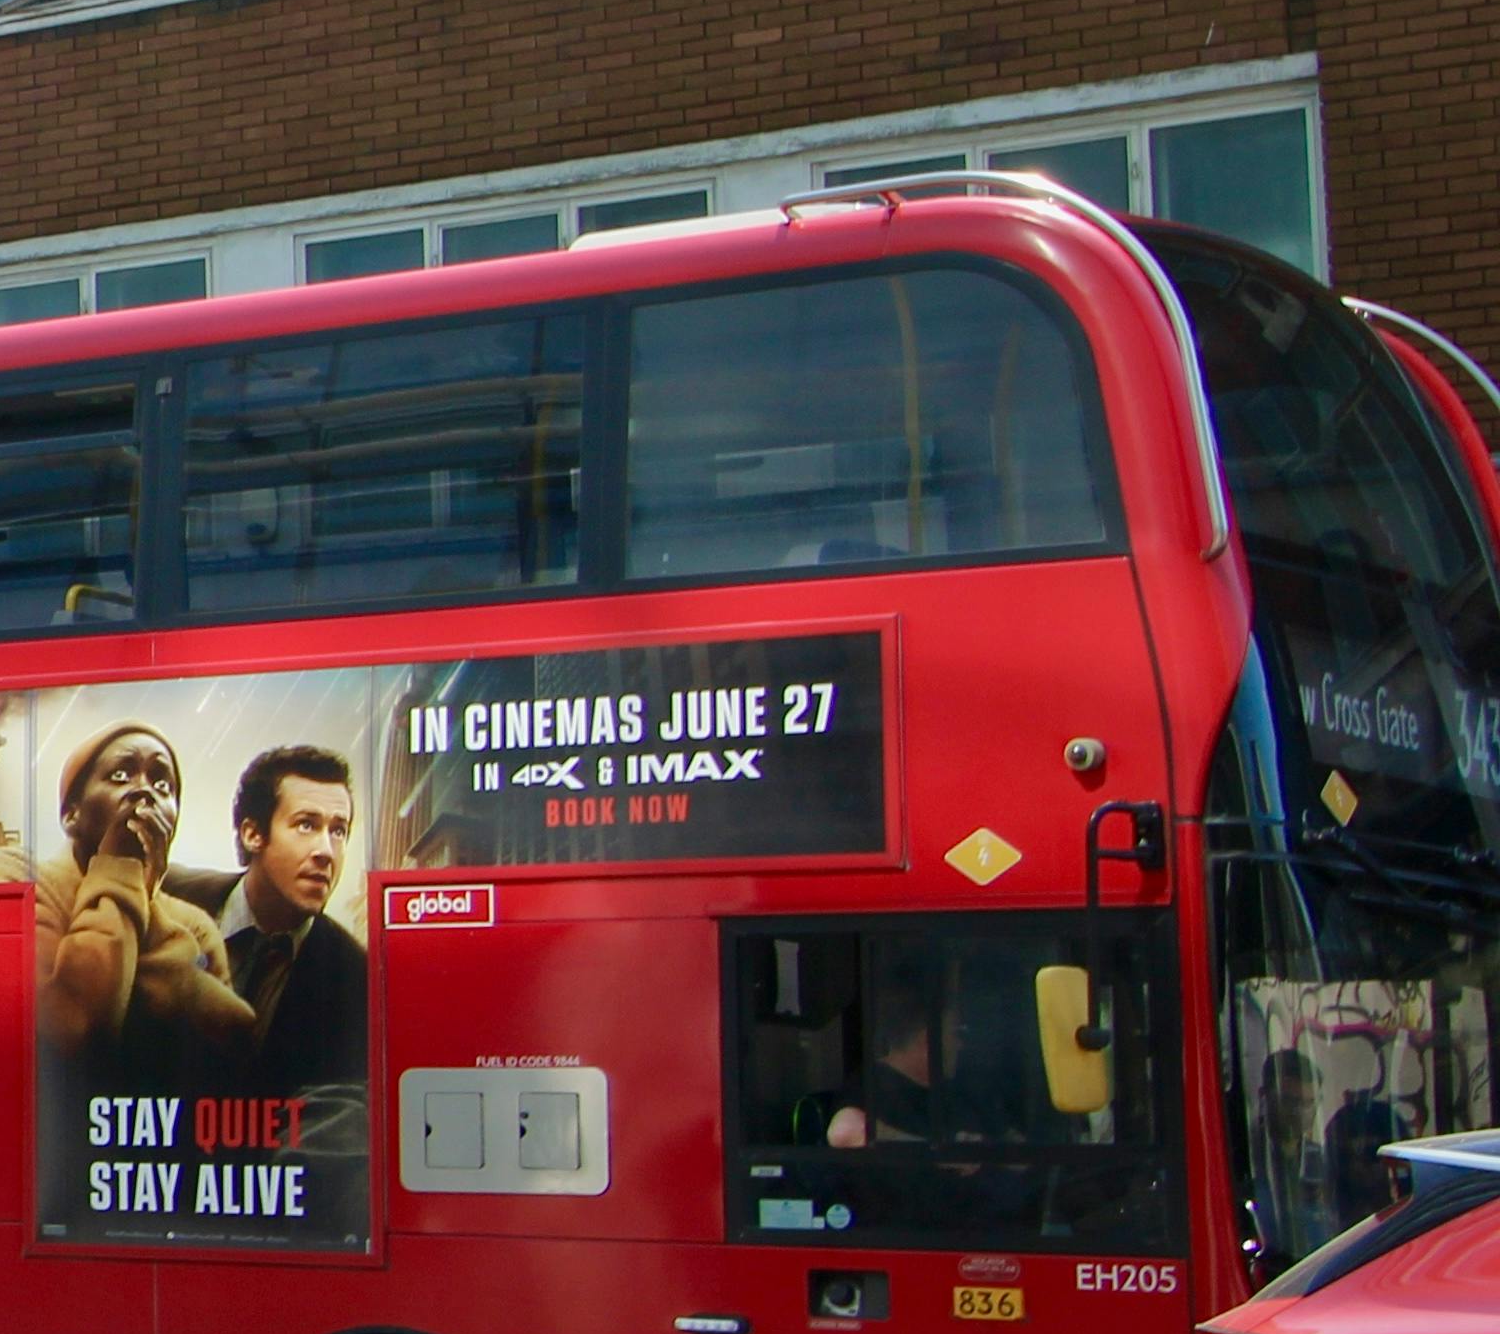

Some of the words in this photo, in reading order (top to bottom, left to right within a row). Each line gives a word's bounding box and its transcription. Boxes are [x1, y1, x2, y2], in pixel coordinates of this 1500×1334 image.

[410, 706, 448, 754] IN
[463, 694, 643, 752] CINEMAS
[658, 687, 767, 742] JUNE
[783, 683, 835, 735] 27
[1322, 672, 1370, 739] Cross
[1376, 687, 1419, 751] Gate
[472, 762, 499, 791] IN
[510, 756, 585, 790] 4DX
[598, 757, 613, 786] &
[627, 748, 762, 784] IMAX
[546, 796, 616, 827] BOOK
[629, 793, 691, 823] NOW
[406, 890, 472, 922] global
[88, 1096, 181, 1147] STAY
[194, 1097, 307, 1155] QUIET
[88, 1161, 181, 1212] STAY
[194, 1163, 305, 1216] ALIVE
[1075, 1263, 1177, 1293] EH205
[958, 1290, 1016, 1317] 836
